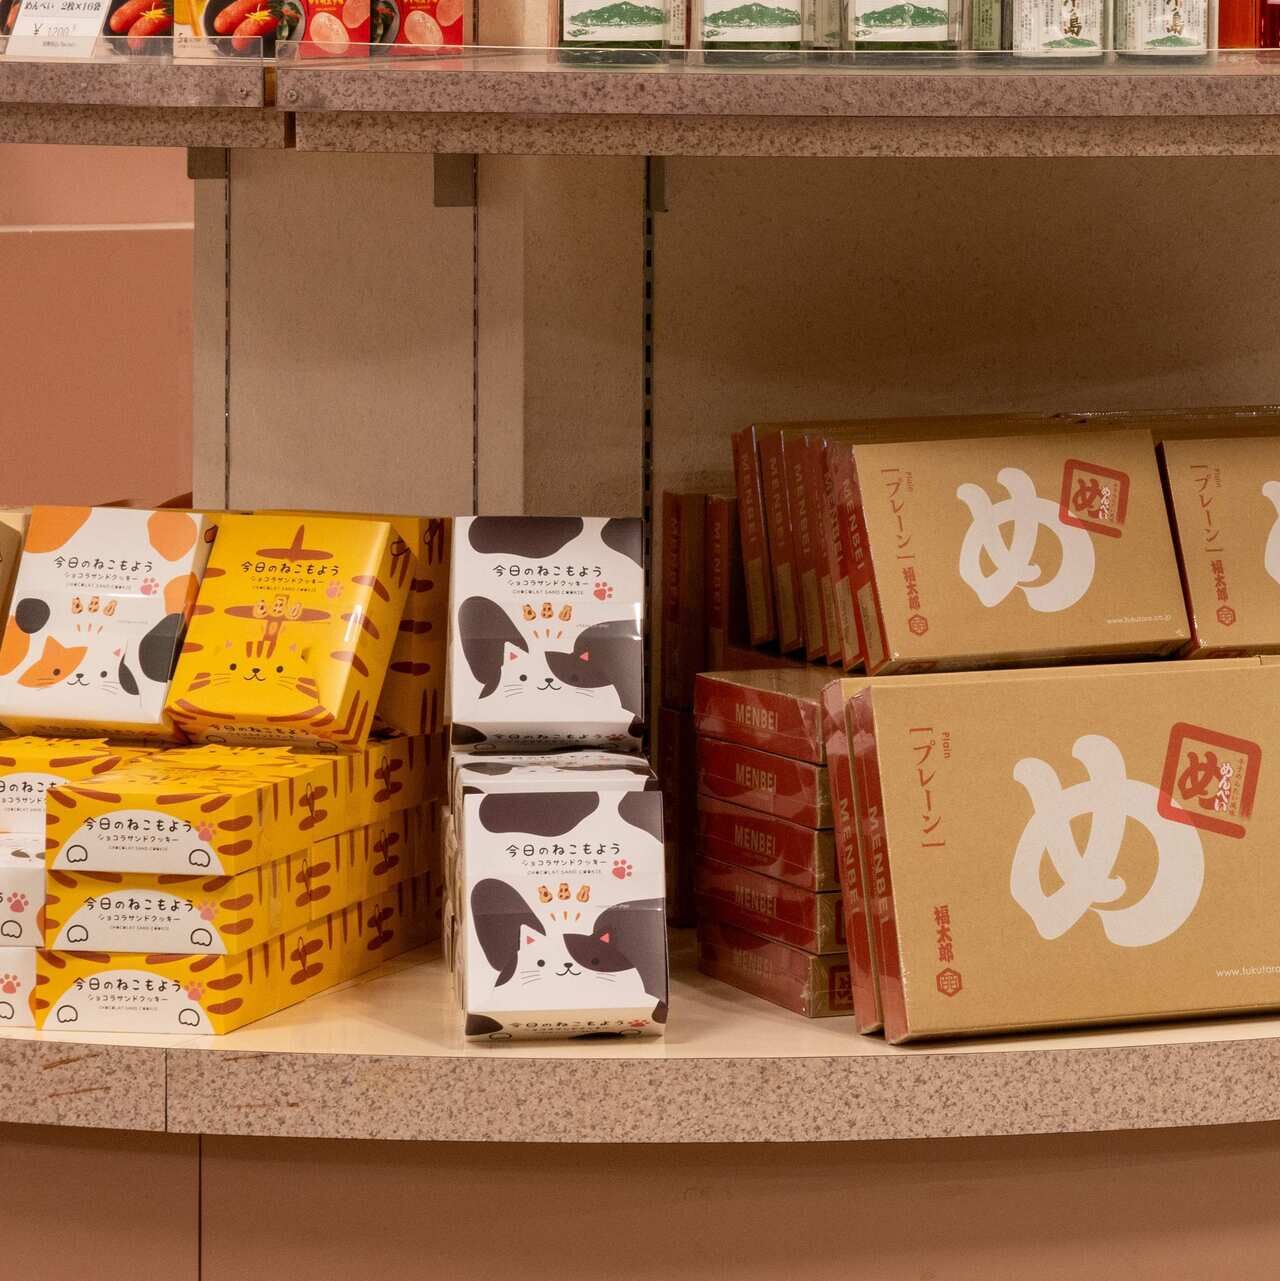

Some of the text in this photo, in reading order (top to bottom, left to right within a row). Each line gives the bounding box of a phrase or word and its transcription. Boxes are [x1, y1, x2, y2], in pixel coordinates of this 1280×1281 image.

[957, 467, 1095, 612] め
[54, 556, 153, 573] 今日のねこもよう
[241, 561, 340, 576] 今日のねこもよう
[493, 565, 602, 577] 今日のねこもよう
[735, 704, 778, 730] MENBEI
[943, 731, 953, 760] Plain
[736, 763, 777, 793] MENBEI
[84, 817, 192, 832] 今日のねこもよう
[98, 835, 179, 843] ショコラサンドクッキー
[506, 843, 622, 858] 今日のねこもよう
[735, 821, 777, 855] MENBEI
[1011, 733, 1205, 948] め
[837, 798, 860, 914] MENBEI
[866, 806, 890, 923] MENBEI
[84, 897, 194, 912] 今日のねこもよう
[735, 883, 777, 918] MENBEI
[99, 914, 180, 923] ショコラサンドクッキー
[933, 905, 954, 963] 福太郎
[73, 977, 181, 992] 今日のねこもよう
